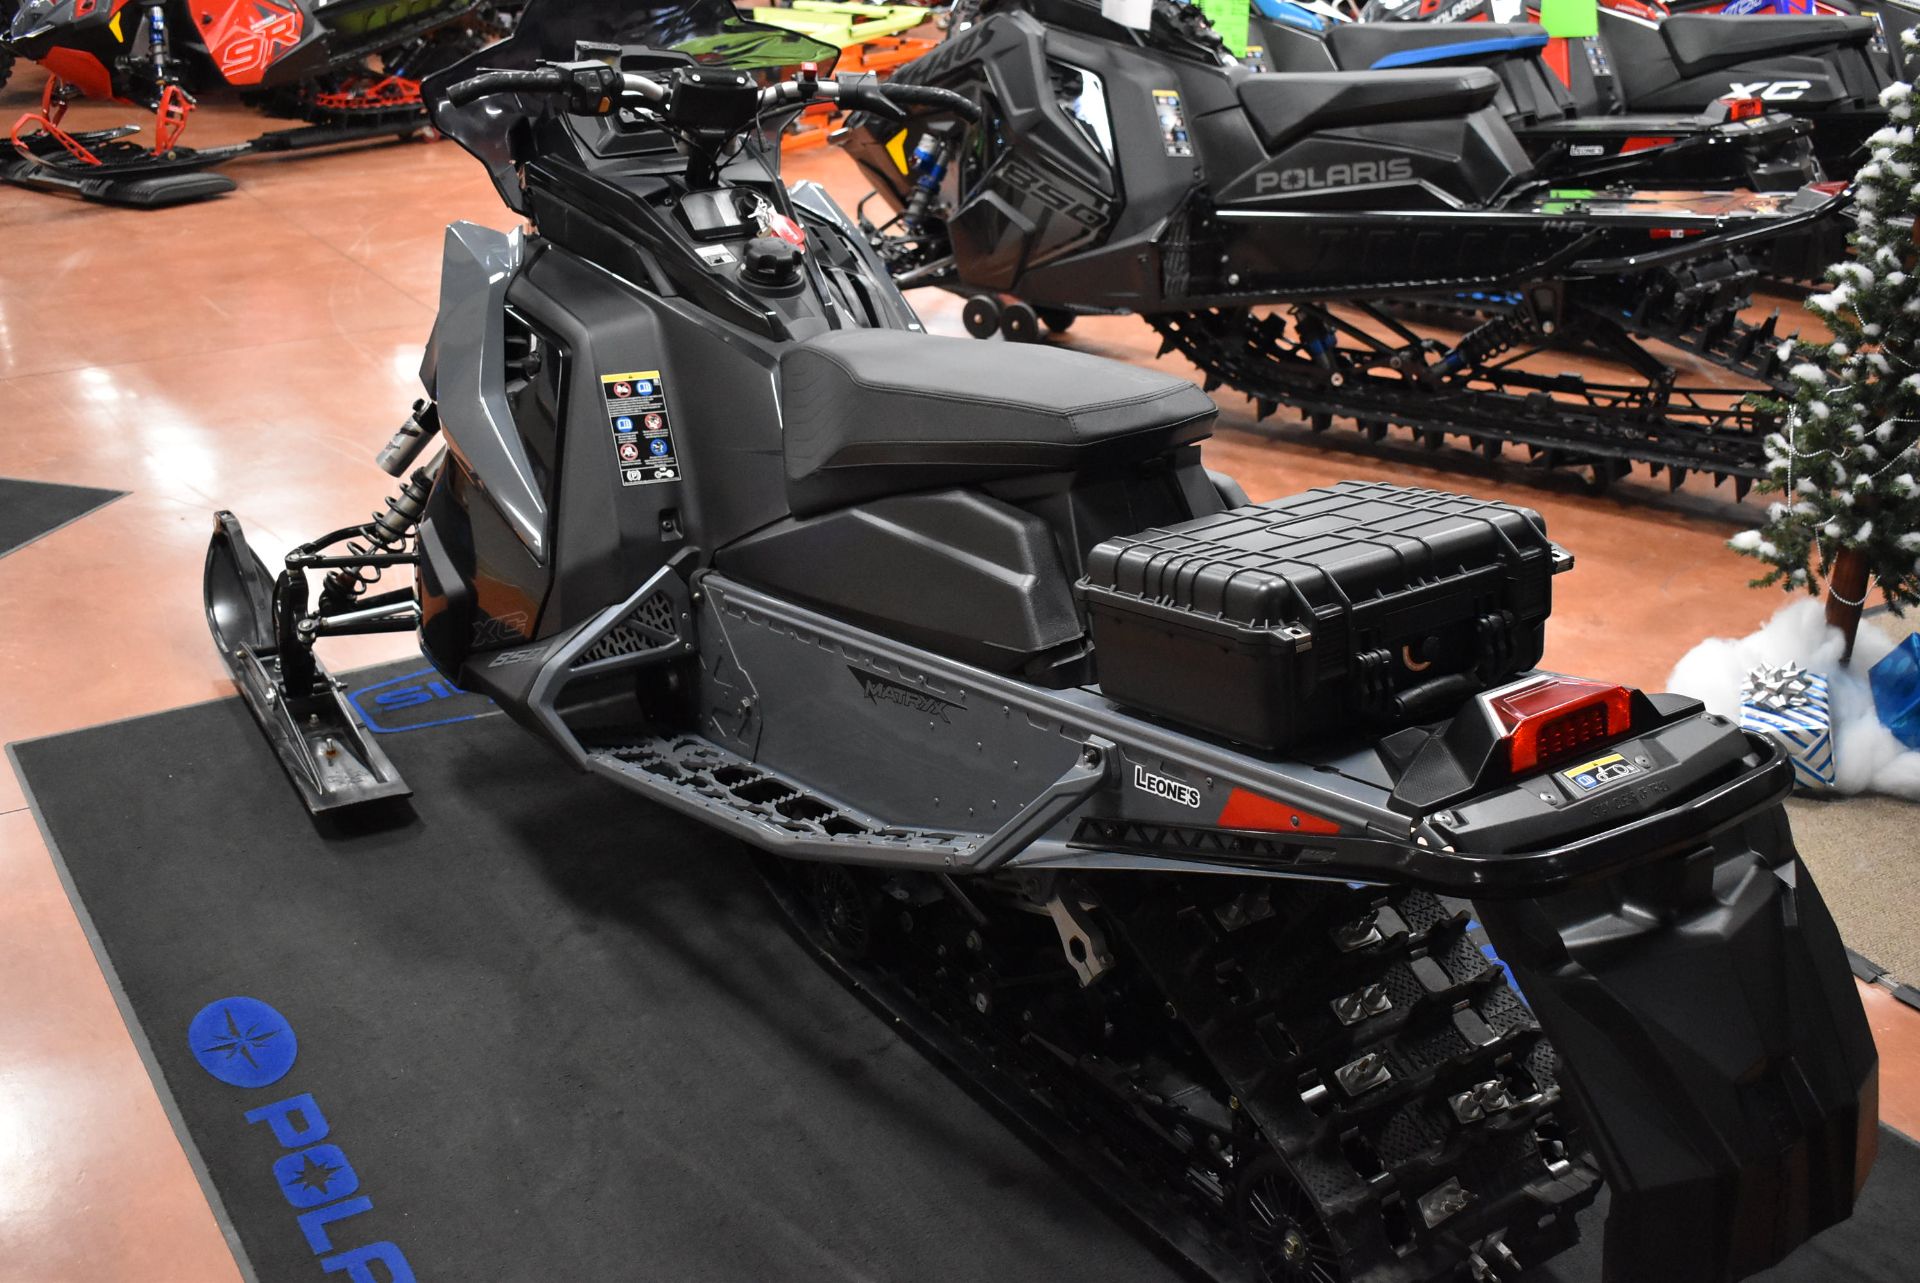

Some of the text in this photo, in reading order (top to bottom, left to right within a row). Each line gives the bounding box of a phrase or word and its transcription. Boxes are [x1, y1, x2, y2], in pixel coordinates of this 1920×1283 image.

[221, 12, 301, 76] 9R
[1717, 80, 1812, 101] XC
[1002, 160, 1110, 230] 850
[1256, 158, 1414, 193] POLARIS
[472, 610, 529, 647] XC
[488, 646, 548, 668] 850
[864, 680, 952, 724] MATRYX
[1134, 765, 1201, 808] LEONE'S
